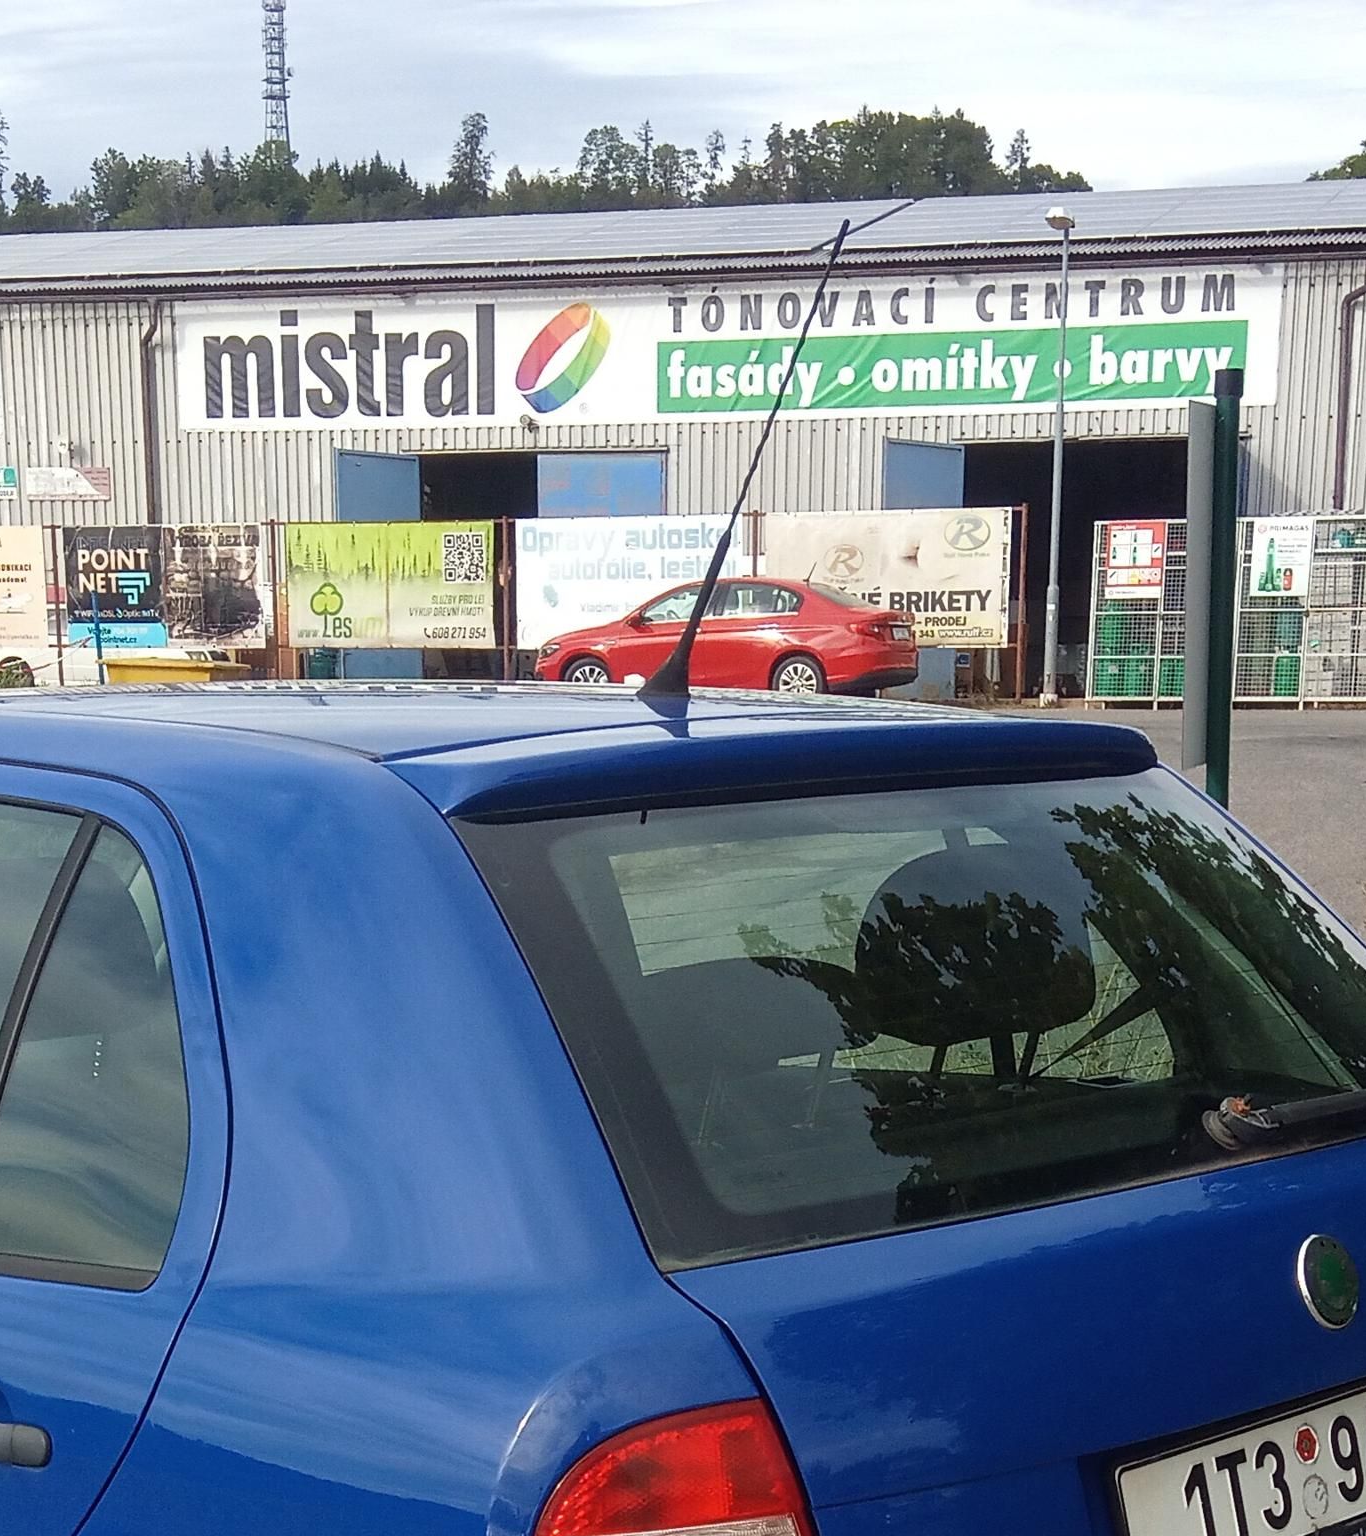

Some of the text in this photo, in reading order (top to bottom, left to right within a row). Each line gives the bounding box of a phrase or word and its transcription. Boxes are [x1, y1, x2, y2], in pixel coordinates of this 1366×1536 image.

[667, 273, 1236, 333] TÓNOVACÍ CENTRUM
[202, 303, 496, 419] mistral
[666, 334, 1234, 408] fasády omítky barvy
[522, 525, 615, 559] Opravy
[77, 548, 149, 571] POINT
[78, 572, 119, 594] NET
[890, 589, 992, 613] BRIKETY
[432, 627, 487, 639] 608 271 954
[924, 616, 967, 627] PRODEJ
[918, 630, 935, 638] 343
